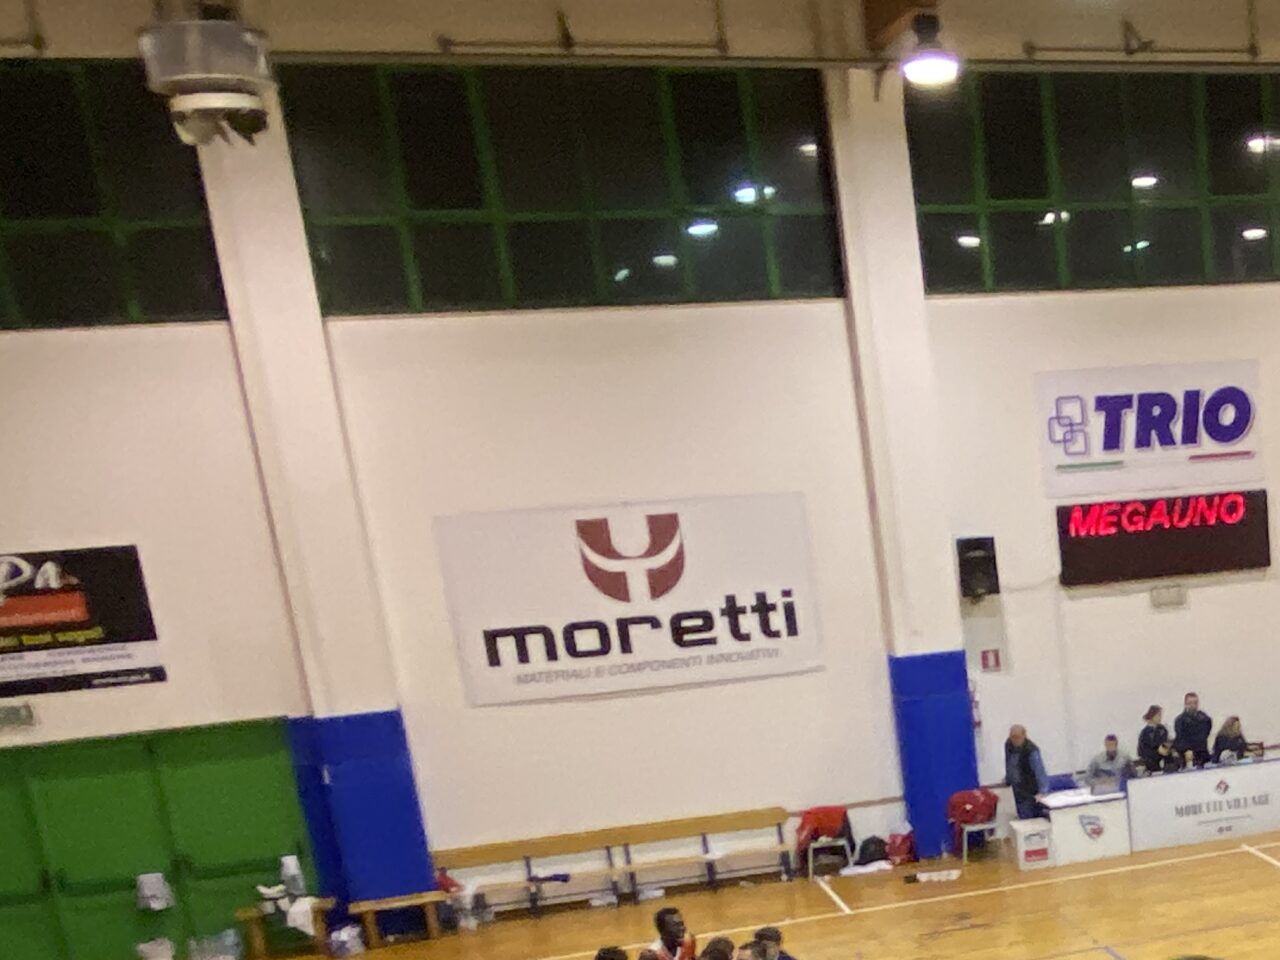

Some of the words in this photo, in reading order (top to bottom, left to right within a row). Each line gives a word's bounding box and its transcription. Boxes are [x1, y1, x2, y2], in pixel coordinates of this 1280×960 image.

[1094, 386, 1254, 452] TRIO
[1068, 493, 1246, 537] MEGAUNO
[483, 588, 799, 668] moretti
[516, 664, 592, 685] MATERIALI
